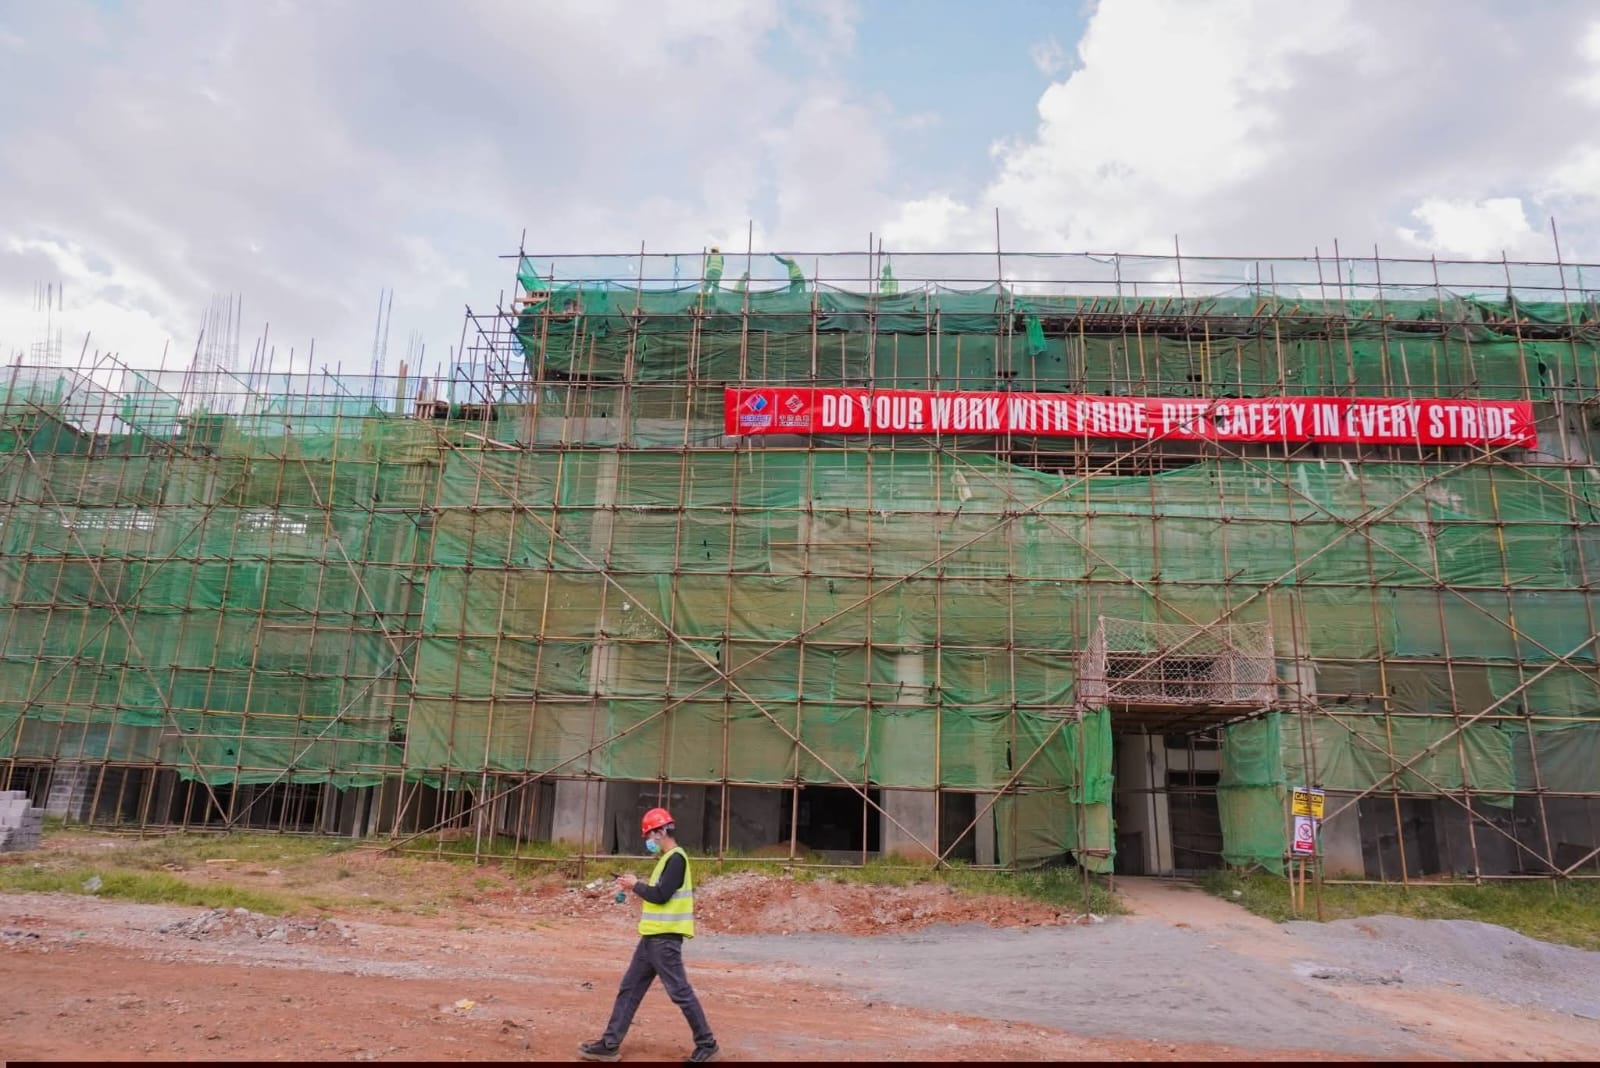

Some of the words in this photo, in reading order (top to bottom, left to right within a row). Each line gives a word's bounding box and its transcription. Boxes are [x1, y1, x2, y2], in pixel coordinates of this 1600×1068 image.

[822, 394, 853, 428] DO
[860, 395, 923, 431] YOUR
[930, 397, 1001, 431] WORK
[1007, 397, 1069, 432] WITH
[1075, 400, 1155, 439] PRIDE,
[1162, 403, 1208, 435] PUT
[1215, 403, 1306, 436] SAFETY
[1312, 403, 1340, 437] IN
[1346, 404, 1421, 438] EVERY
[1428, 405, 1525, 440] STRIDE.
